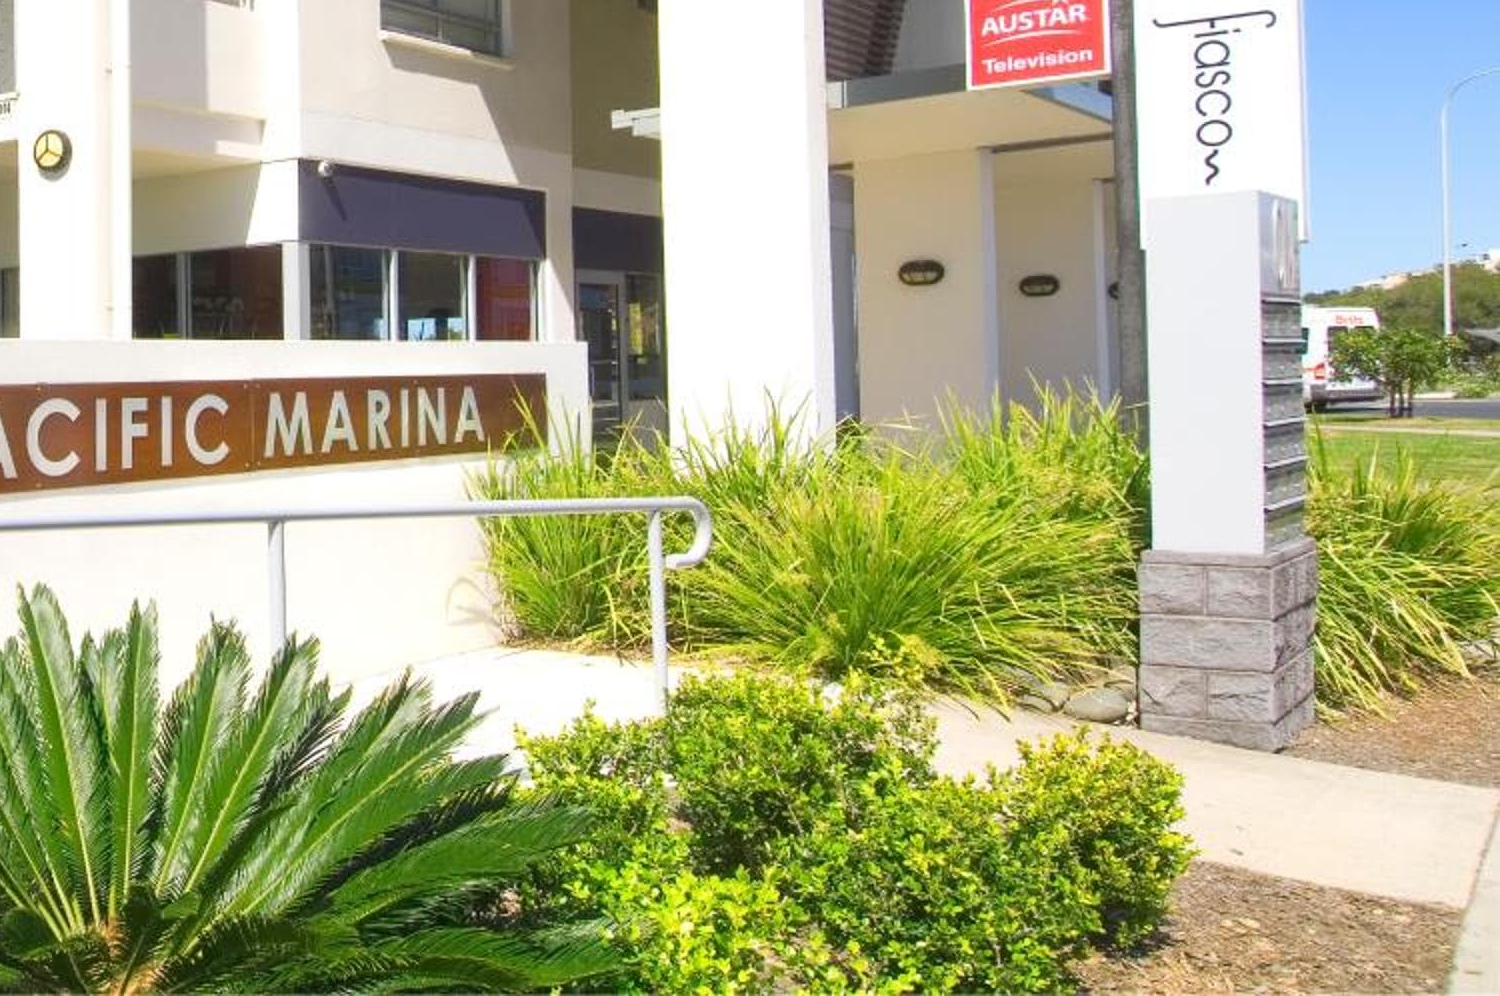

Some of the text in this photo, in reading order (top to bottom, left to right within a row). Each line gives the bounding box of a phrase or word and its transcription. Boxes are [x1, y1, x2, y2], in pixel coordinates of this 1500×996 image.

[980, 3, 1088, 36] AUSTAR
[982, 48, 1094, 75] Television
[265, 385, 486, 457] MARINA
